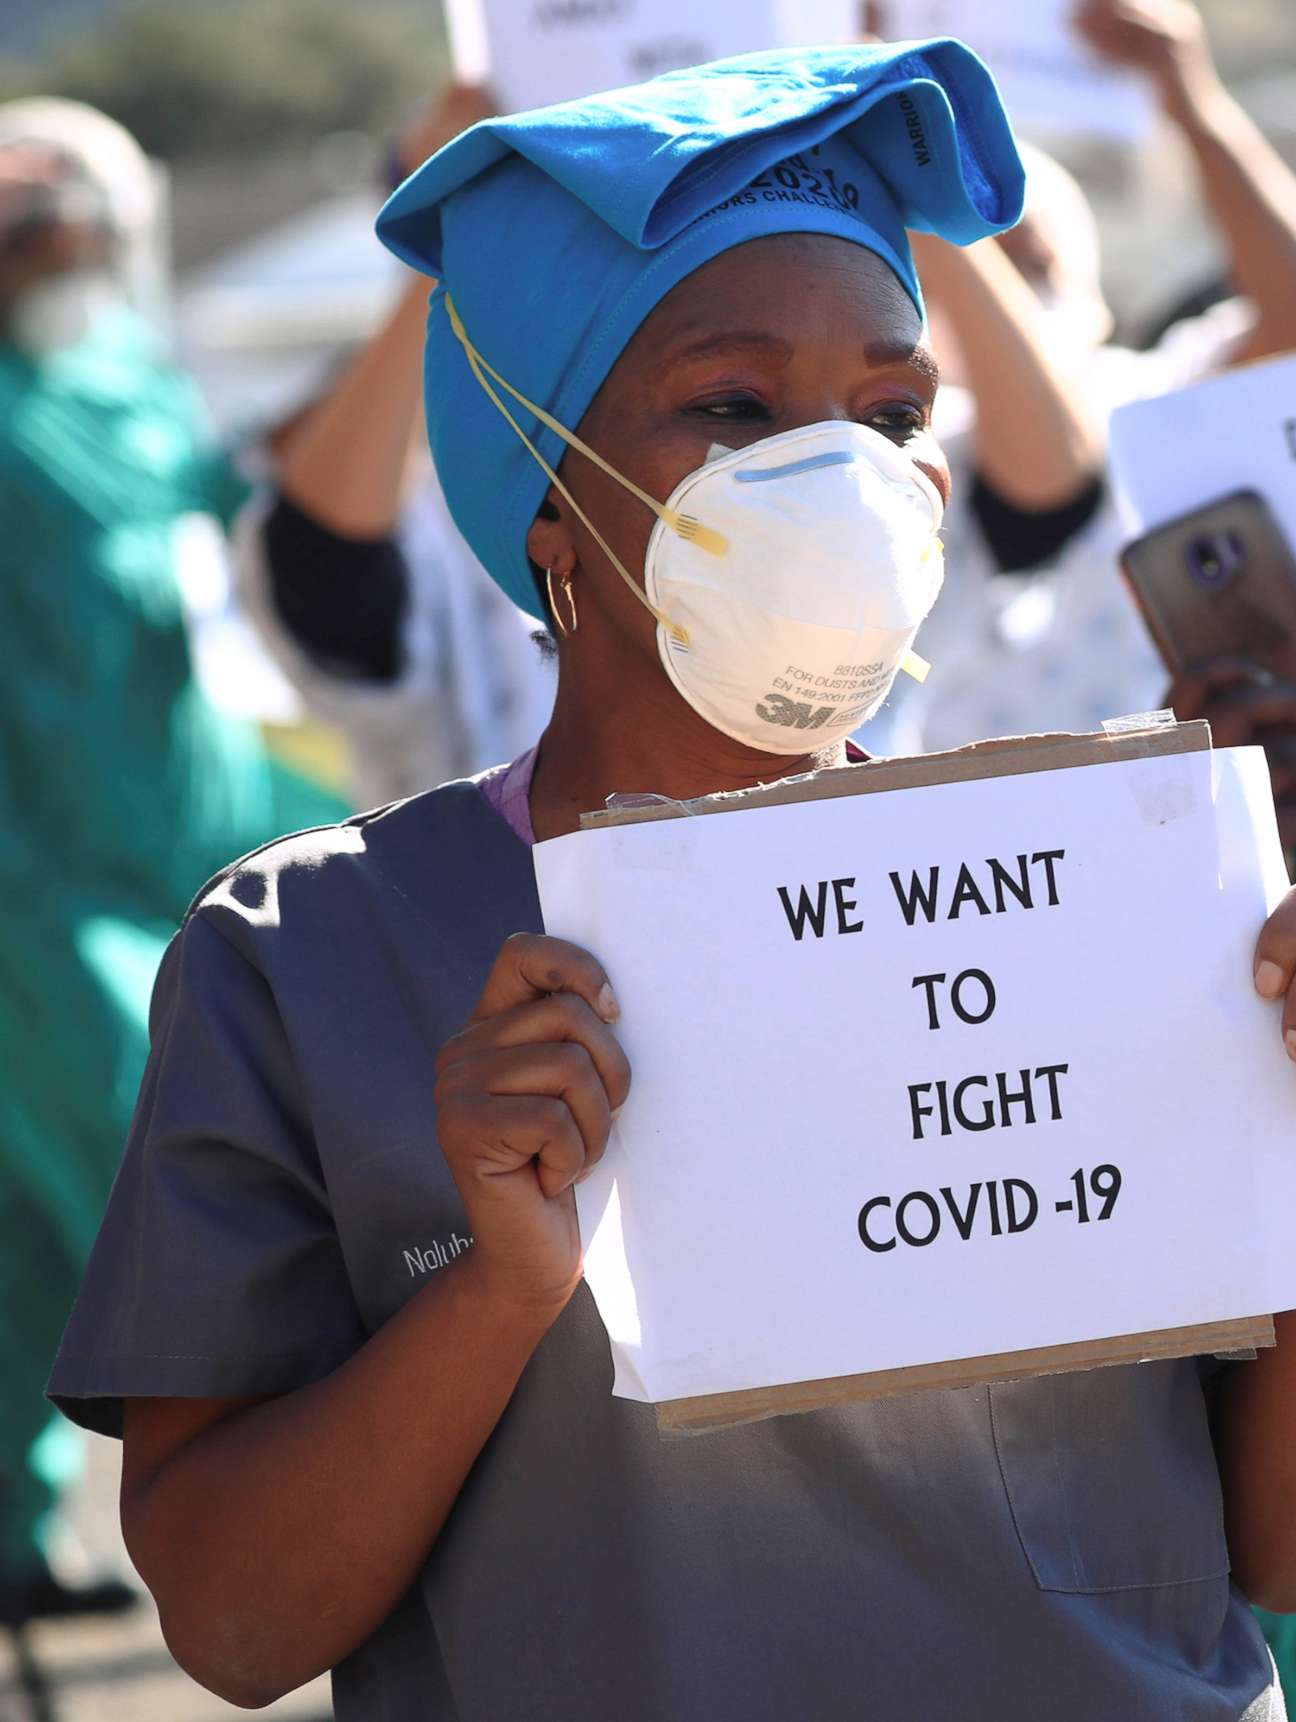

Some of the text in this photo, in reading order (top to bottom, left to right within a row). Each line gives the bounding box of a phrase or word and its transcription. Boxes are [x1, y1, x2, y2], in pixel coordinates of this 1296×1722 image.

[772, 676, 793, 692] EN
[785, 665, 814, 682] FOR
[814, 676, 857, 690] DUSTS
[755, 693, 837, 729] 3M
[777, 849, 1065, 941] WE WANT
[912, 968, 996, 1030] TO
[907, 1063, 1069, 1139] FIGHT
[857, 1163, 1122, 1253] COVID -19
